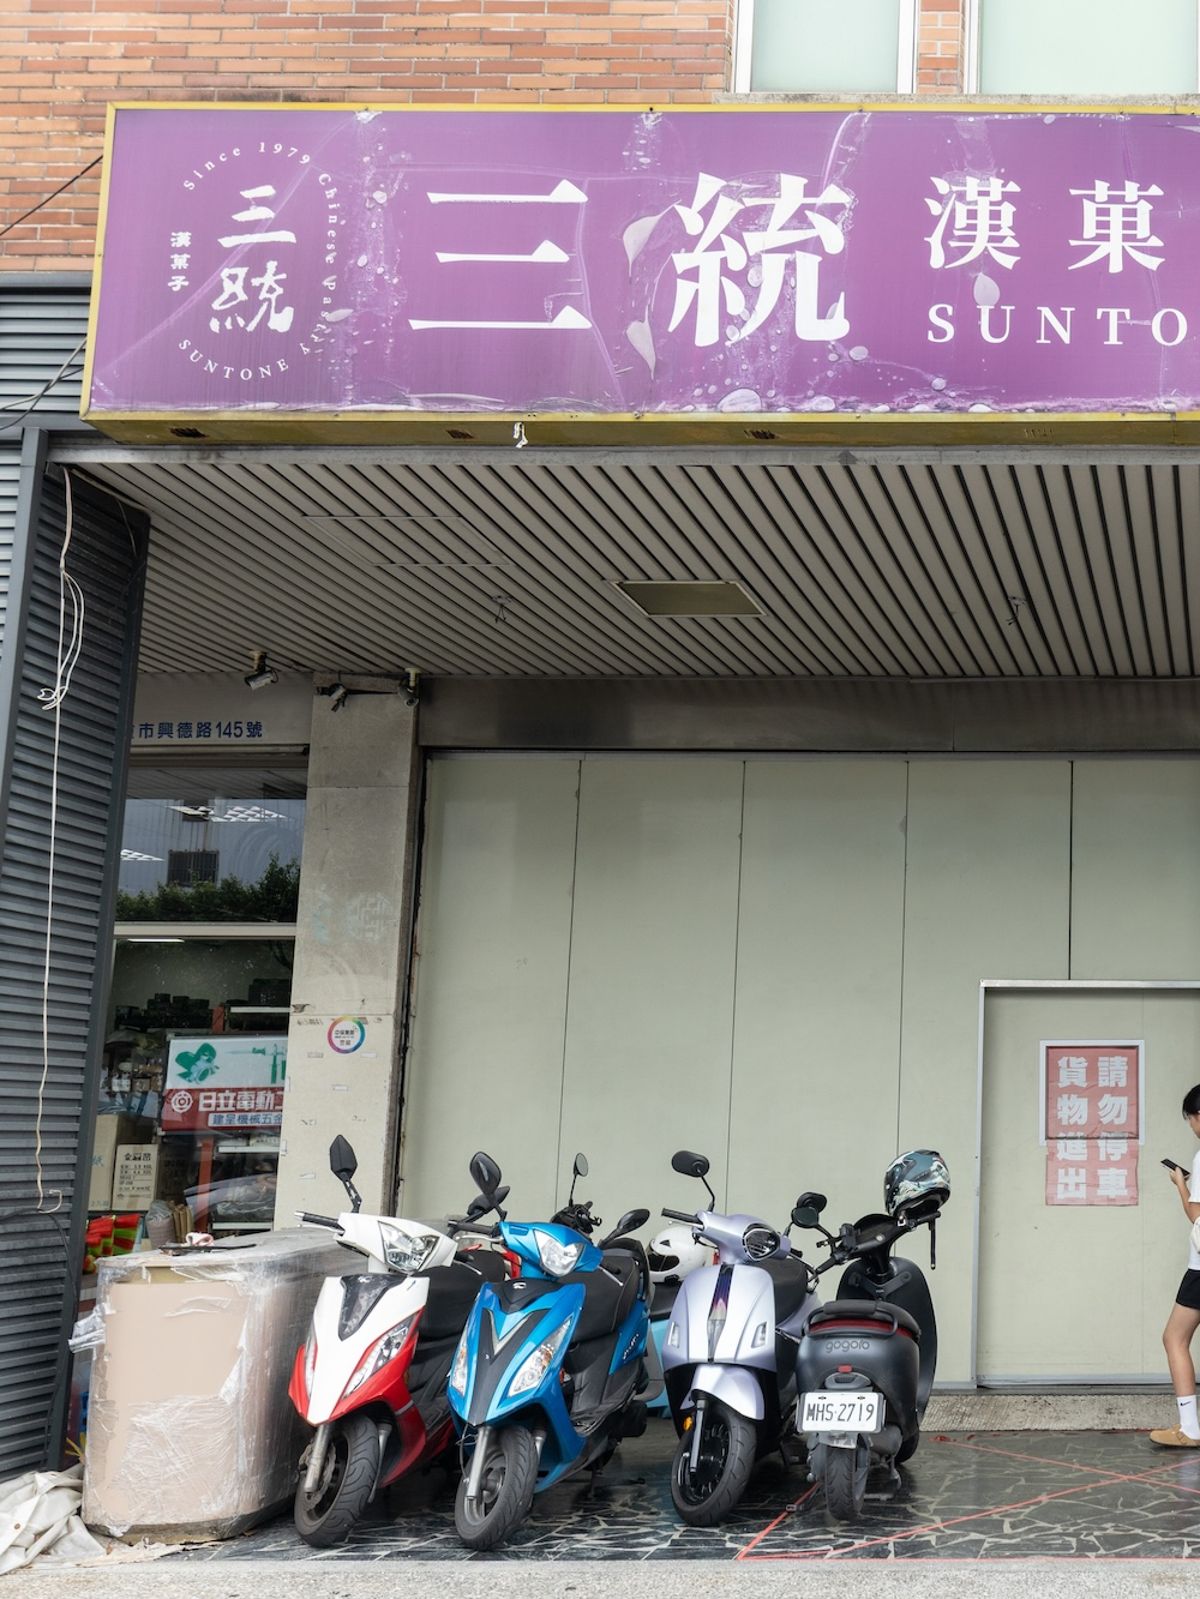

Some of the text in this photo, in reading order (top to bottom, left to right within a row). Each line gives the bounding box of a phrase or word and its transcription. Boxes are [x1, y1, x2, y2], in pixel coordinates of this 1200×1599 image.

[183, 142, 311, 191] Since 1979
[318, 173, 341, 265] Chinese
[167, 231, 192, 292] 漢菓子
[407, 172, 850, 348] 三統
[178, 339, 289, 381] SUNTONE
[131, 721, 263, 739] 市興德路145號
[1056, 1055, 1089, 1201] 貨物進出
[1097, 1055, 1129, 1199] 請勿停車
